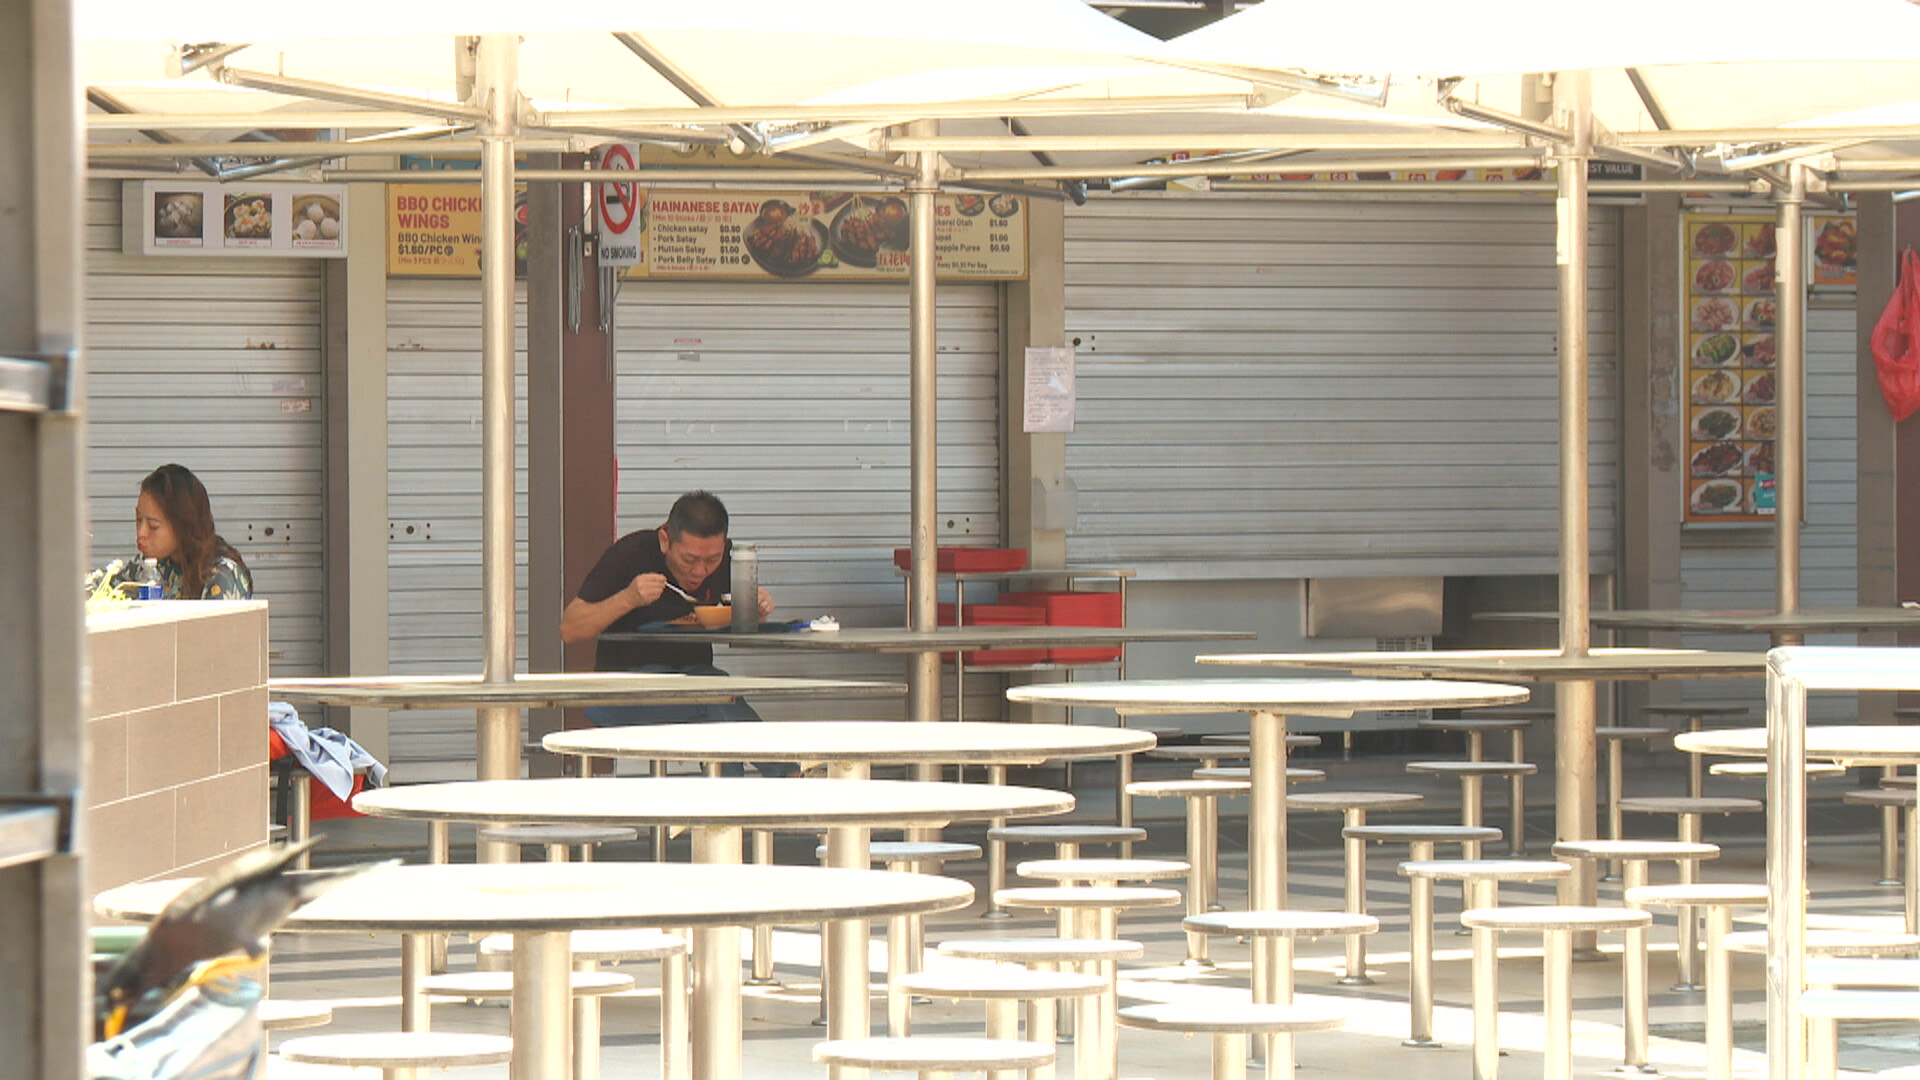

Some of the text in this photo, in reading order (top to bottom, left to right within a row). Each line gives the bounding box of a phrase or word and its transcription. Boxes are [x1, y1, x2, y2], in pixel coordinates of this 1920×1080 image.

[1605, 163, 1634, 174] VALUE
[397, 196, 428, 212] BBQ
[652, 200, 760, 214] HAINANESE SATAY
[935, 205, 951, 216] ES
[398, 213, 450, 229] WINGS
[956, 219, 973, 227] Otah
[657, 224, 687, 233] Chicken
[688, 225, 708, 235] satay
[398, 232, 482, 244] BBQ Chicken Win
[657, 235, 675, 243] Pork
[676, 235, 697, 244] Satay
[601, 246, 637, 259] NO SMOKING
[657, 245, 684, 254] Mutton
[685, 246, 706, 255] Satay
[657, 256, 675, 264] Pork
[676, 256, 695, 265] Belly
[695, 256, 717, 266] Satay
